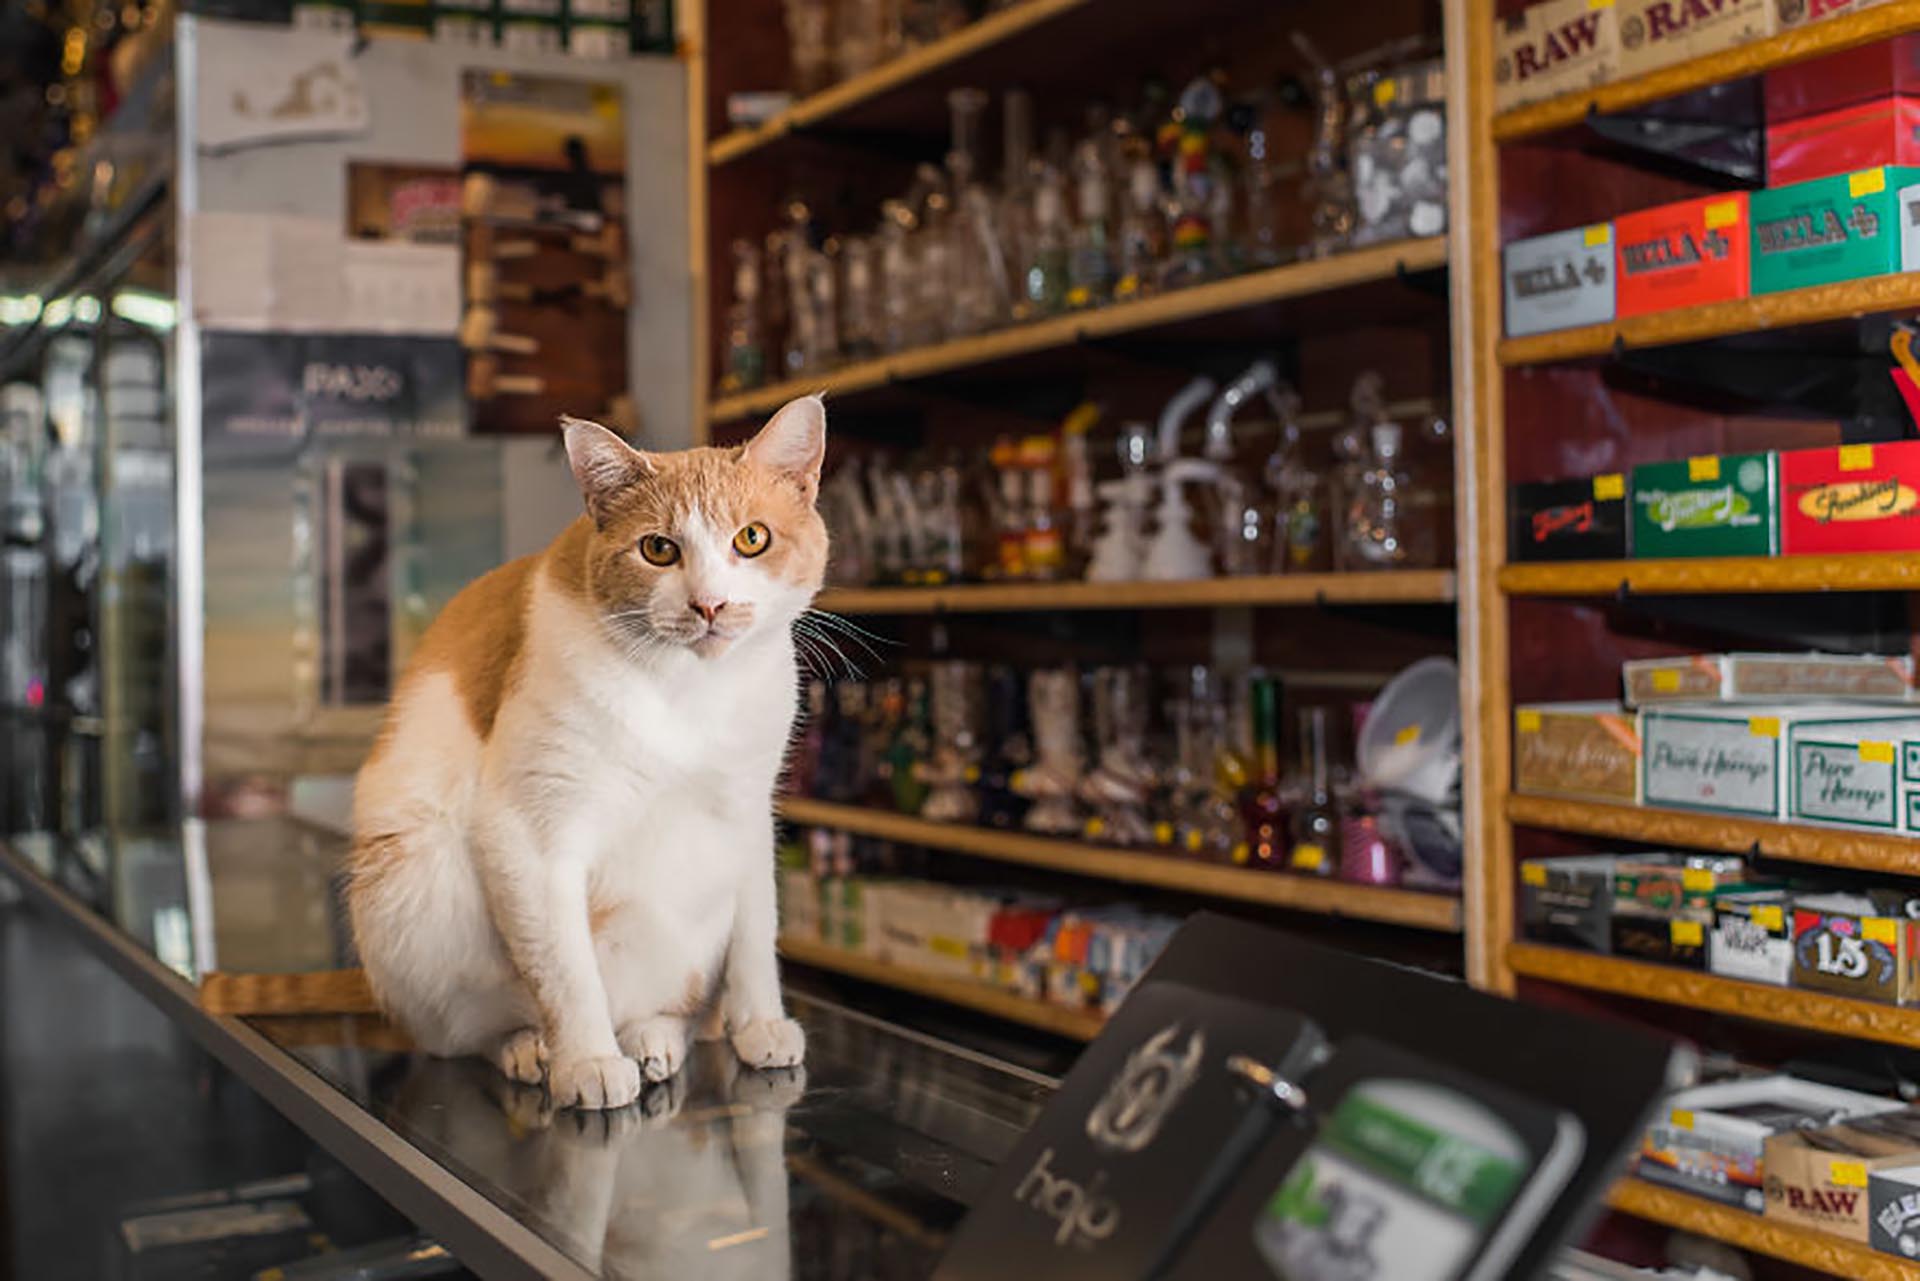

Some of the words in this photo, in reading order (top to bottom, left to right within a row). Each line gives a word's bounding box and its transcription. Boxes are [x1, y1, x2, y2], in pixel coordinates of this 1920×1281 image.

[1645, 0, 1741, 40] RA
[1514, 9, 1602, 79] RAW
[1804, 751, 1855, 777] Pure
[1820, 779, 1887, 811] Hemp
[1786, 1185, 1859, 1216] RAW
